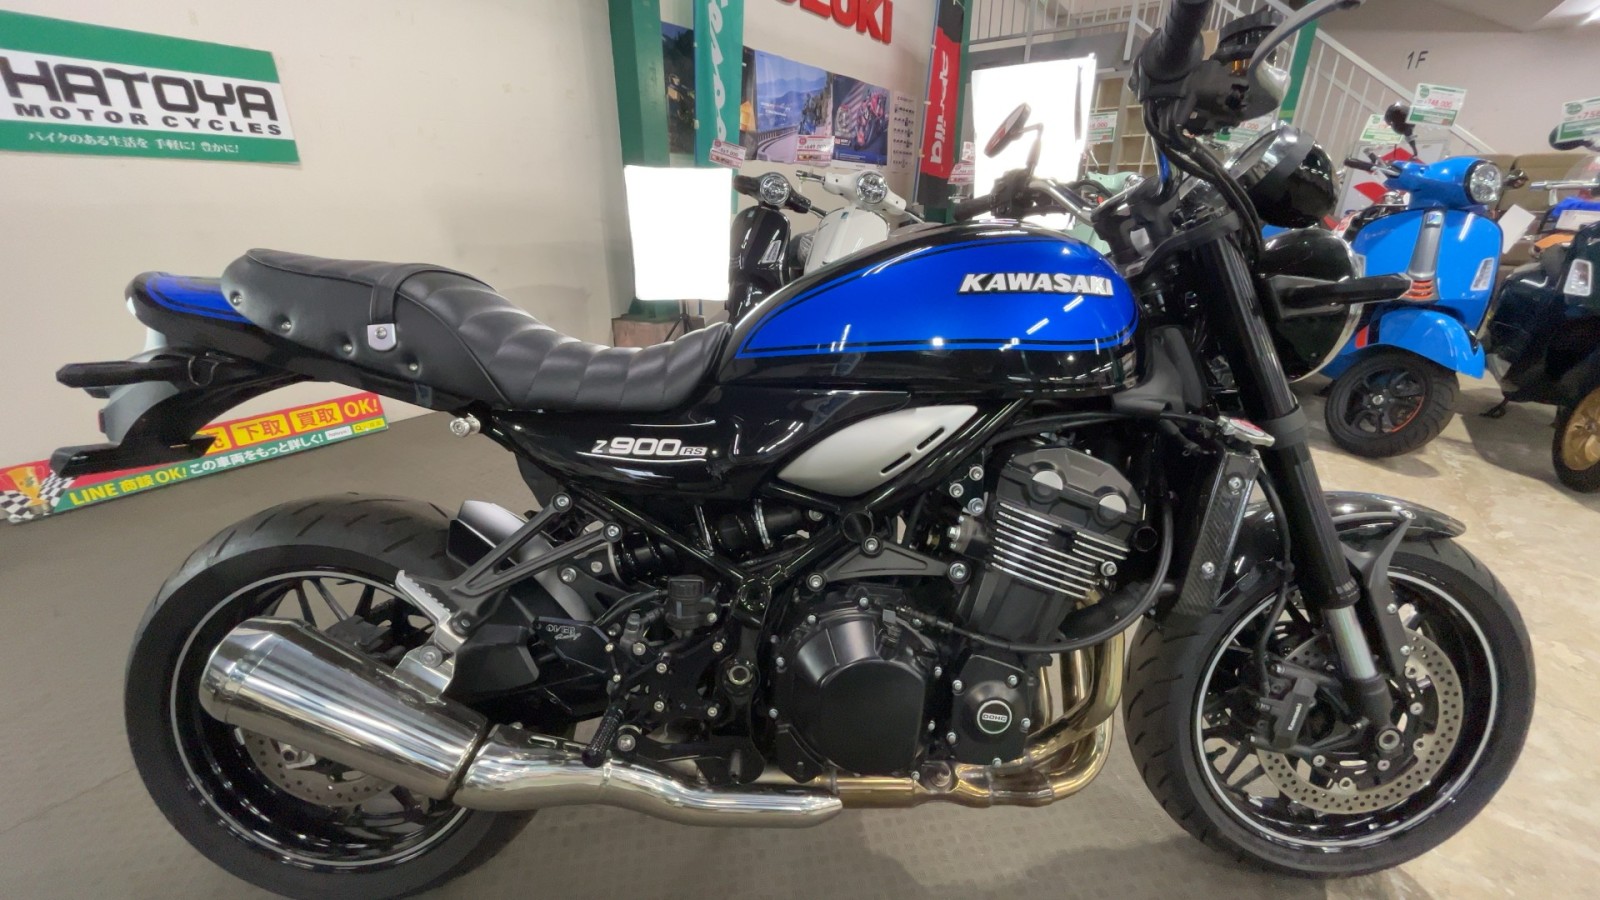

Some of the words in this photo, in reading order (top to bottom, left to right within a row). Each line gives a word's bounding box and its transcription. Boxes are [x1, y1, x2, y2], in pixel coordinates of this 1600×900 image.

[1407, 50, 1429, 70] 1F
[0, 56, 278, 121] HATOYA
[14, 103, 148, 126] MOTOR
[162, 115, 282, 136] CYCLES
[958, 273, 1114, 296] KAWASAKI
[238, 419, 284, 441] 下取
[296, 407, 337, 429] 買取
[344, 398, 378, 417] OK!
[69, 483, 119, 506] LINE
[155, 467, 187, 483] OK!
[189, 433, 323, 475] この車両をもっと詳しく!
